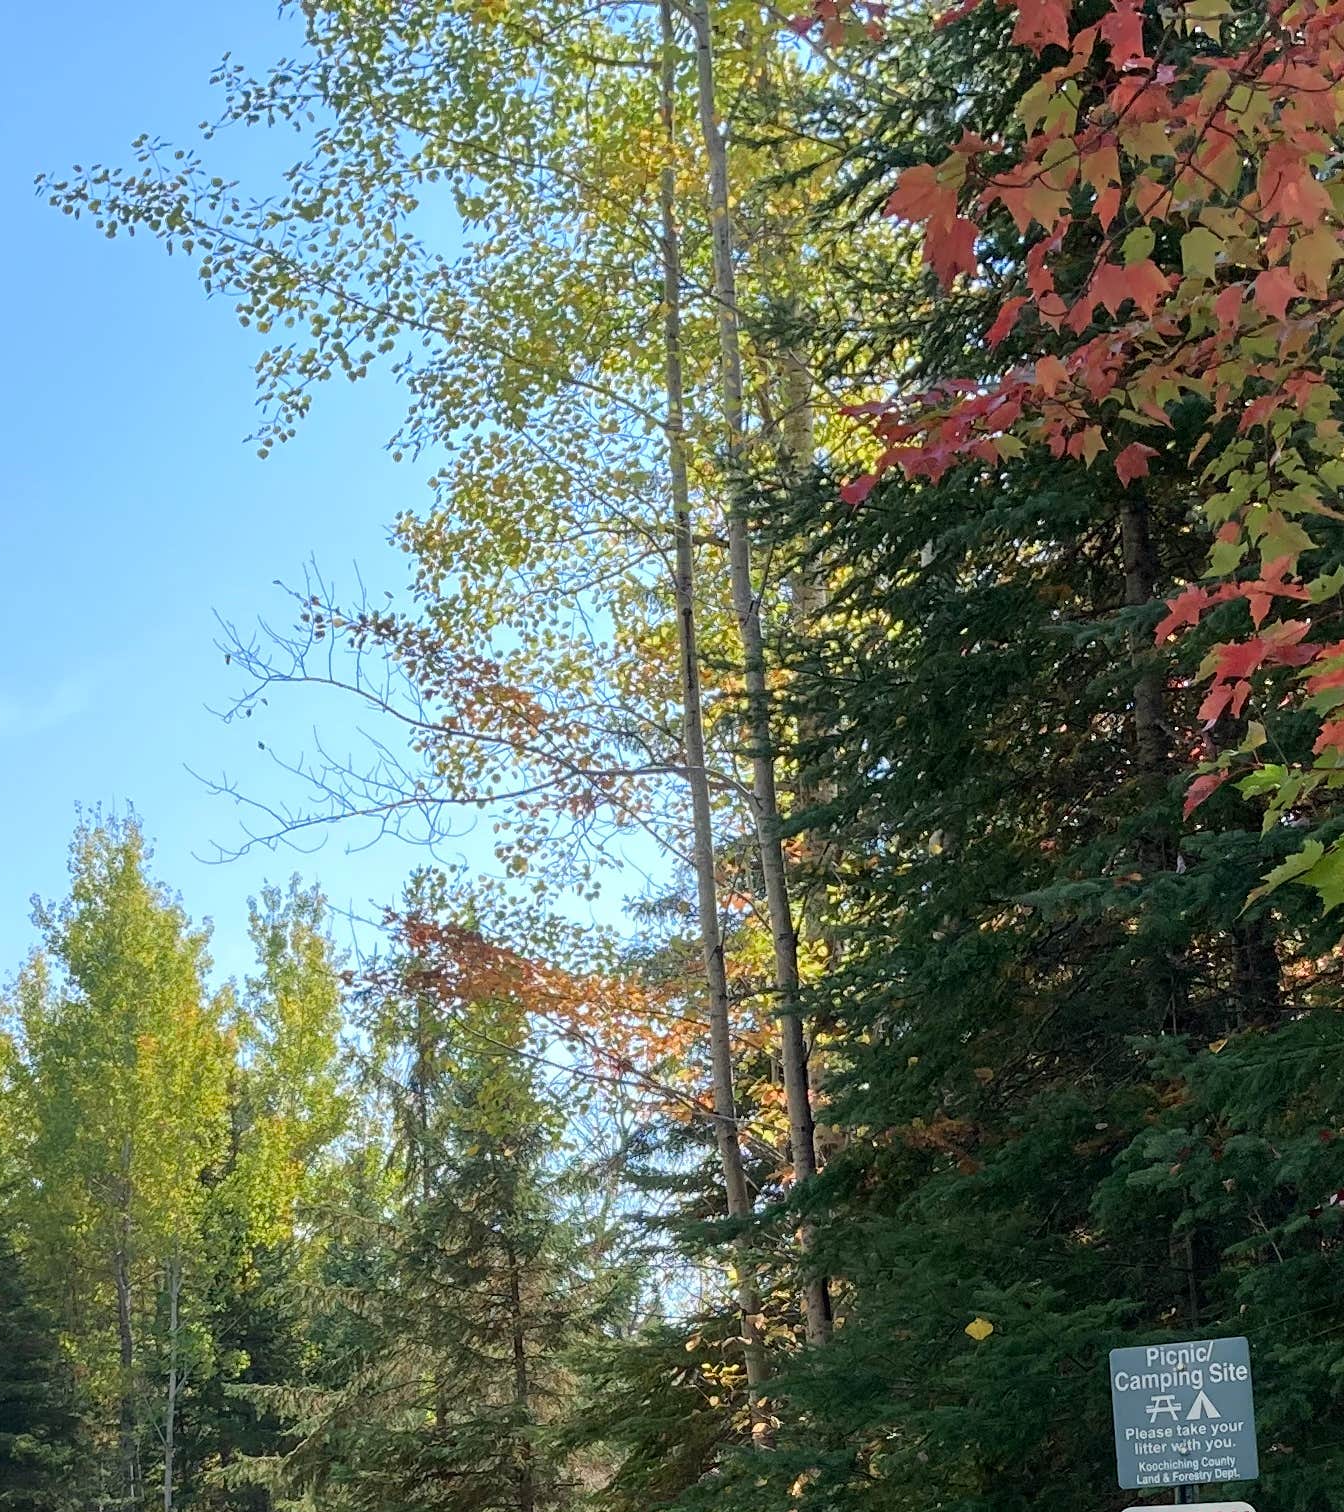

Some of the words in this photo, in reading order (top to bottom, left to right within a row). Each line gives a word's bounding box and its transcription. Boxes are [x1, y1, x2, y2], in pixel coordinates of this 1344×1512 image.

[1146, 1342, 1213, 1367] Picnic/
[1115, 1368, 1203, 1392] Camping
[1209, 1362, 1248, 1383] Site
[1126, 1427, 1173, 1440] Please
[1177, 1424, 1206, 1436] take
[1211, 1422, 1244, 1436] your
[1135, 1441, 1167, 1455] litter
[1171, 1439, 1200, 1453] with
[1206, 1439, 1236, 1451] you.
[1139, 1459, 1198, 1472] Koochiching
[1201, 1456, 1235, 1469] County
[1137, 1474, 1160, 1484] Land
[1163, 1473, 1170, 1482] &
[1173, 1471, 1212, 1482] Forestry
[1215, 1468, 1240, 1479] Dept.
